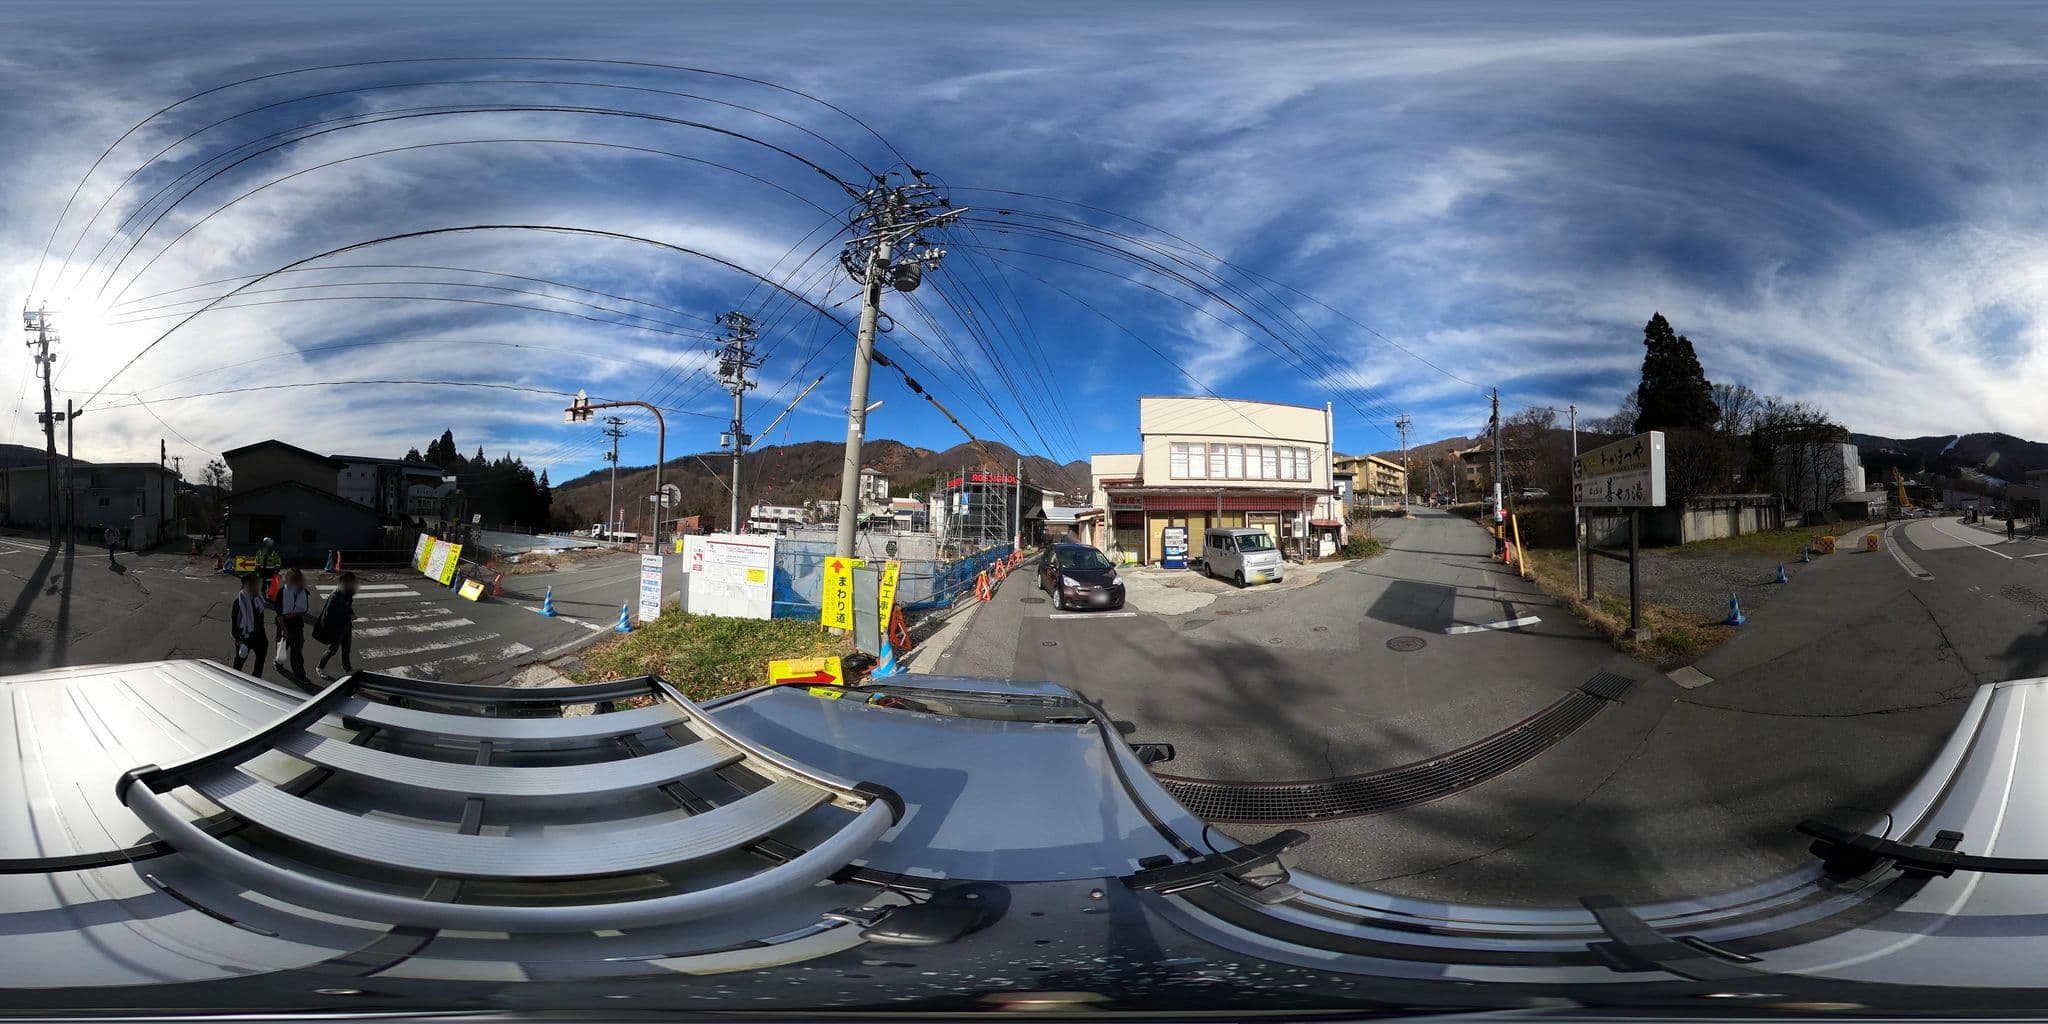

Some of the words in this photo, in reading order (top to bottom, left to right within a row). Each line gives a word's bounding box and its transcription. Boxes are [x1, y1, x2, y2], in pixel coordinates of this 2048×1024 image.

[836, 576, 847, 624] まわり道
[879, 589, 891, 622] 工事中
